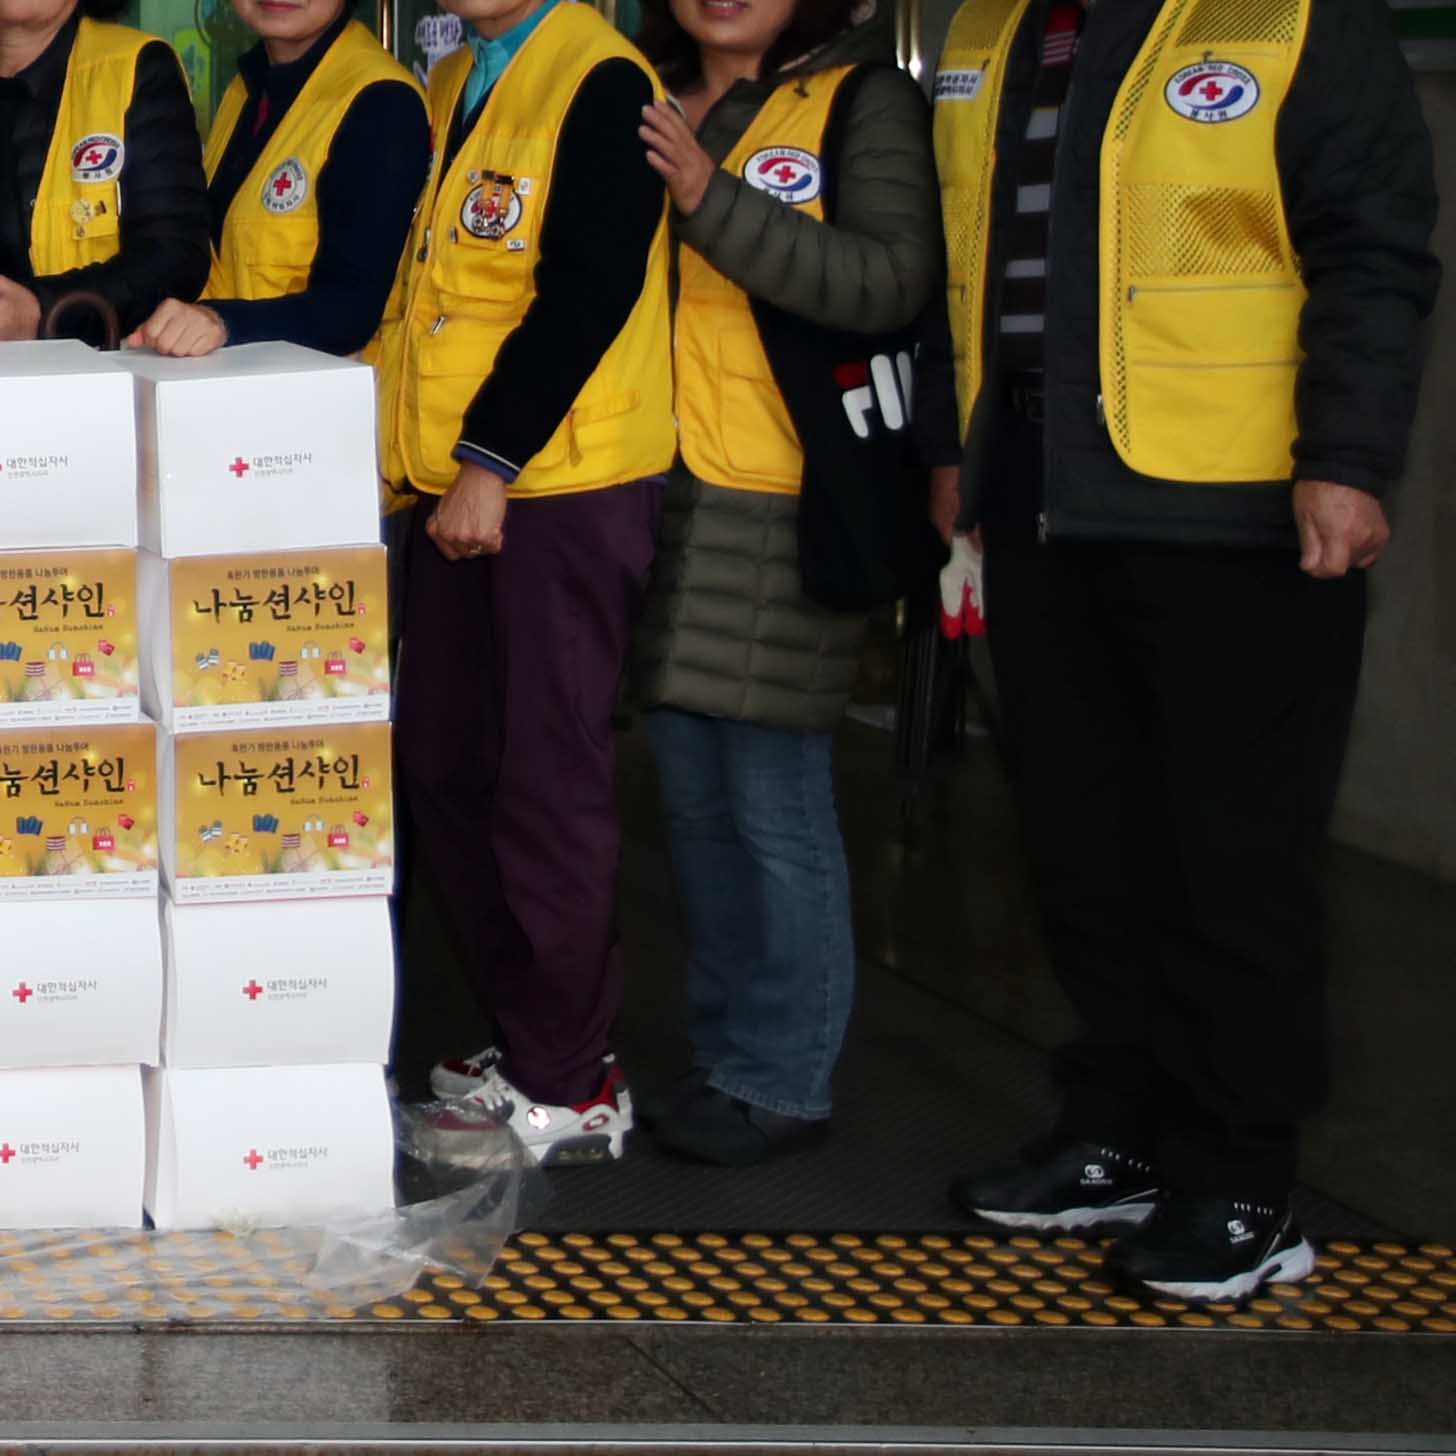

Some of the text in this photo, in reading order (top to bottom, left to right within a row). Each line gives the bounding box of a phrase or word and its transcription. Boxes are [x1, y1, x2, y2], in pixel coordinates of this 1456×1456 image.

[6, 455, 68, 469] 대한적십자사
[253, 453, 312, 468] 대한적십자사
[194, 580, 356, 624] 나눔션샤인
[199, 754, 360, 796] 나눔션샤인
[37, 980, 97, 994] 대한적십자사
[267, 978, 327, 991] 대한적십자사
[20, 1141, 79, 1155] 대한적십자사
[267, 1147, 327, 1161] 대한적십자사
